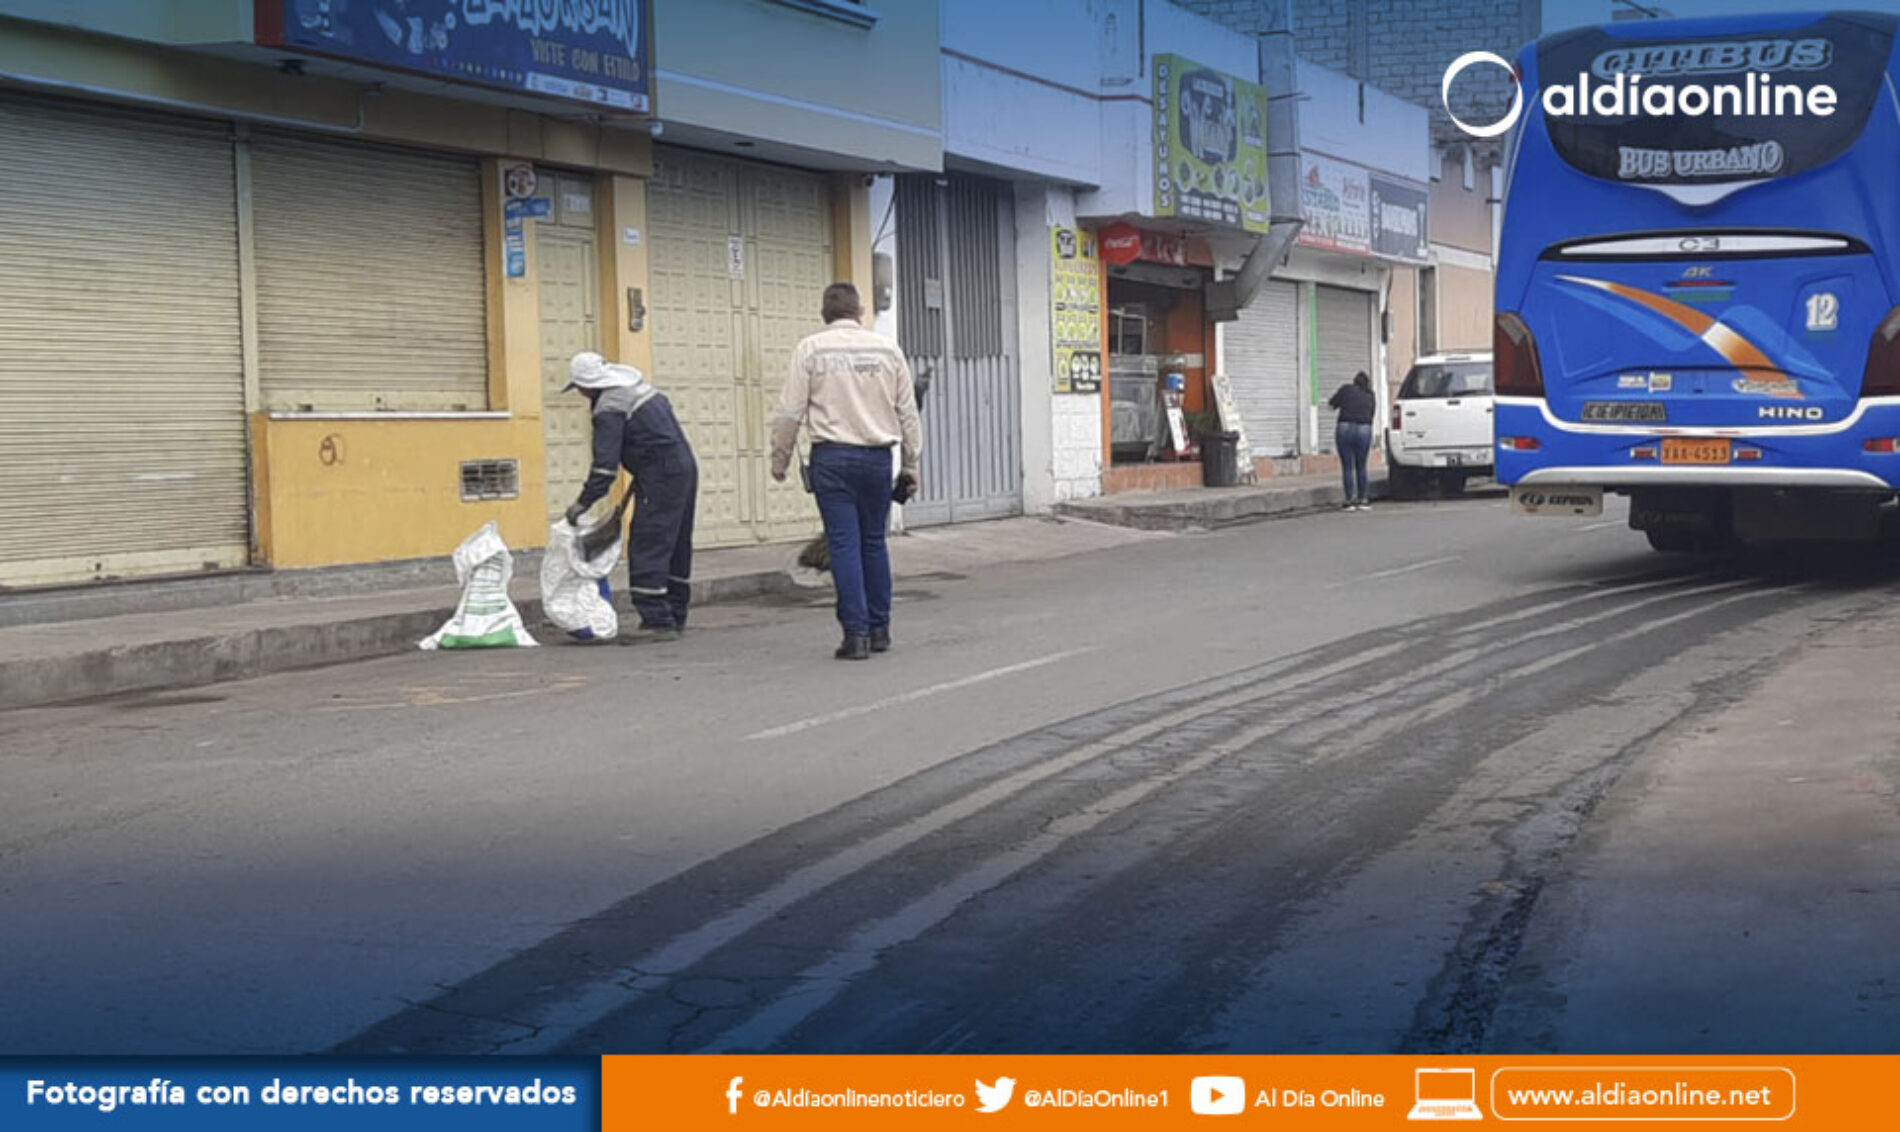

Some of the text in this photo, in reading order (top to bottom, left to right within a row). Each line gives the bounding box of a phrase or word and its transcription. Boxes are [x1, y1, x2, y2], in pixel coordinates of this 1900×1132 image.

[1591, 38, 1833, 80] CITIBUS
[1618, 140, 1783, 178] BUS URBANO
[1679, 237, 1720, 251] C3
[1806, 292, 1839, 331] 12
[1758, 406, 1823, 420] HINO
